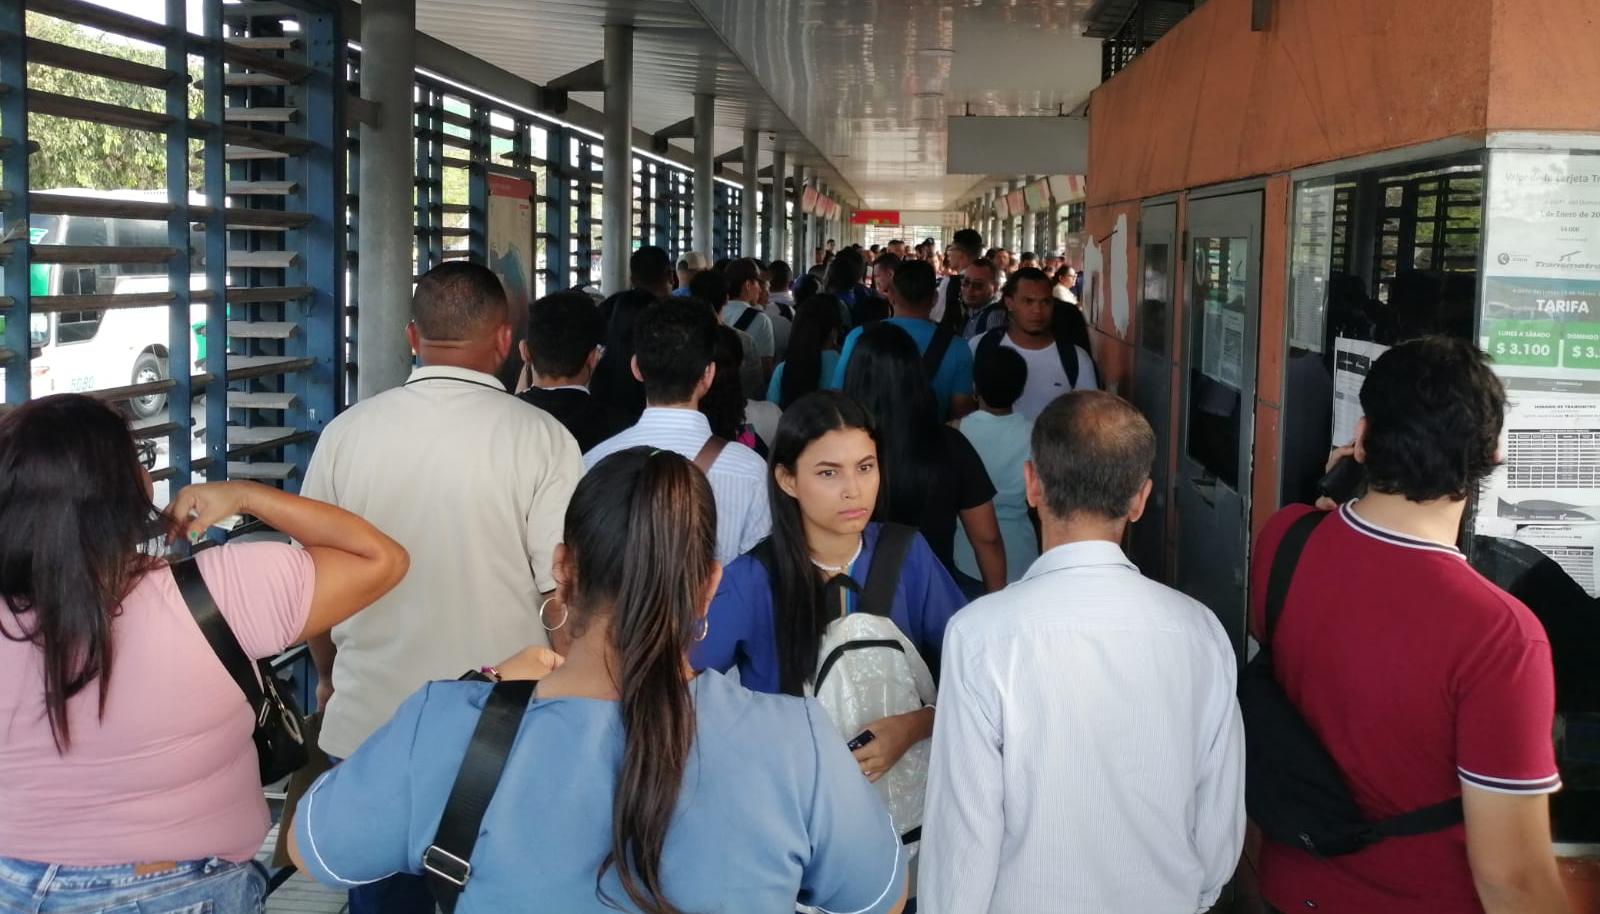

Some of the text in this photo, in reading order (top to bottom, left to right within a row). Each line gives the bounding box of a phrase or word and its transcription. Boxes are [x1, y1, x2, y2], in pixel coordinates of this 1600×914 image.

[1579, 210, 1588, 218] de
[1536, 299, 1589, 314] TARIFA
[1496, 342, 1551, 356] $ 3.100
[1572, 345, 1582, 358] $
